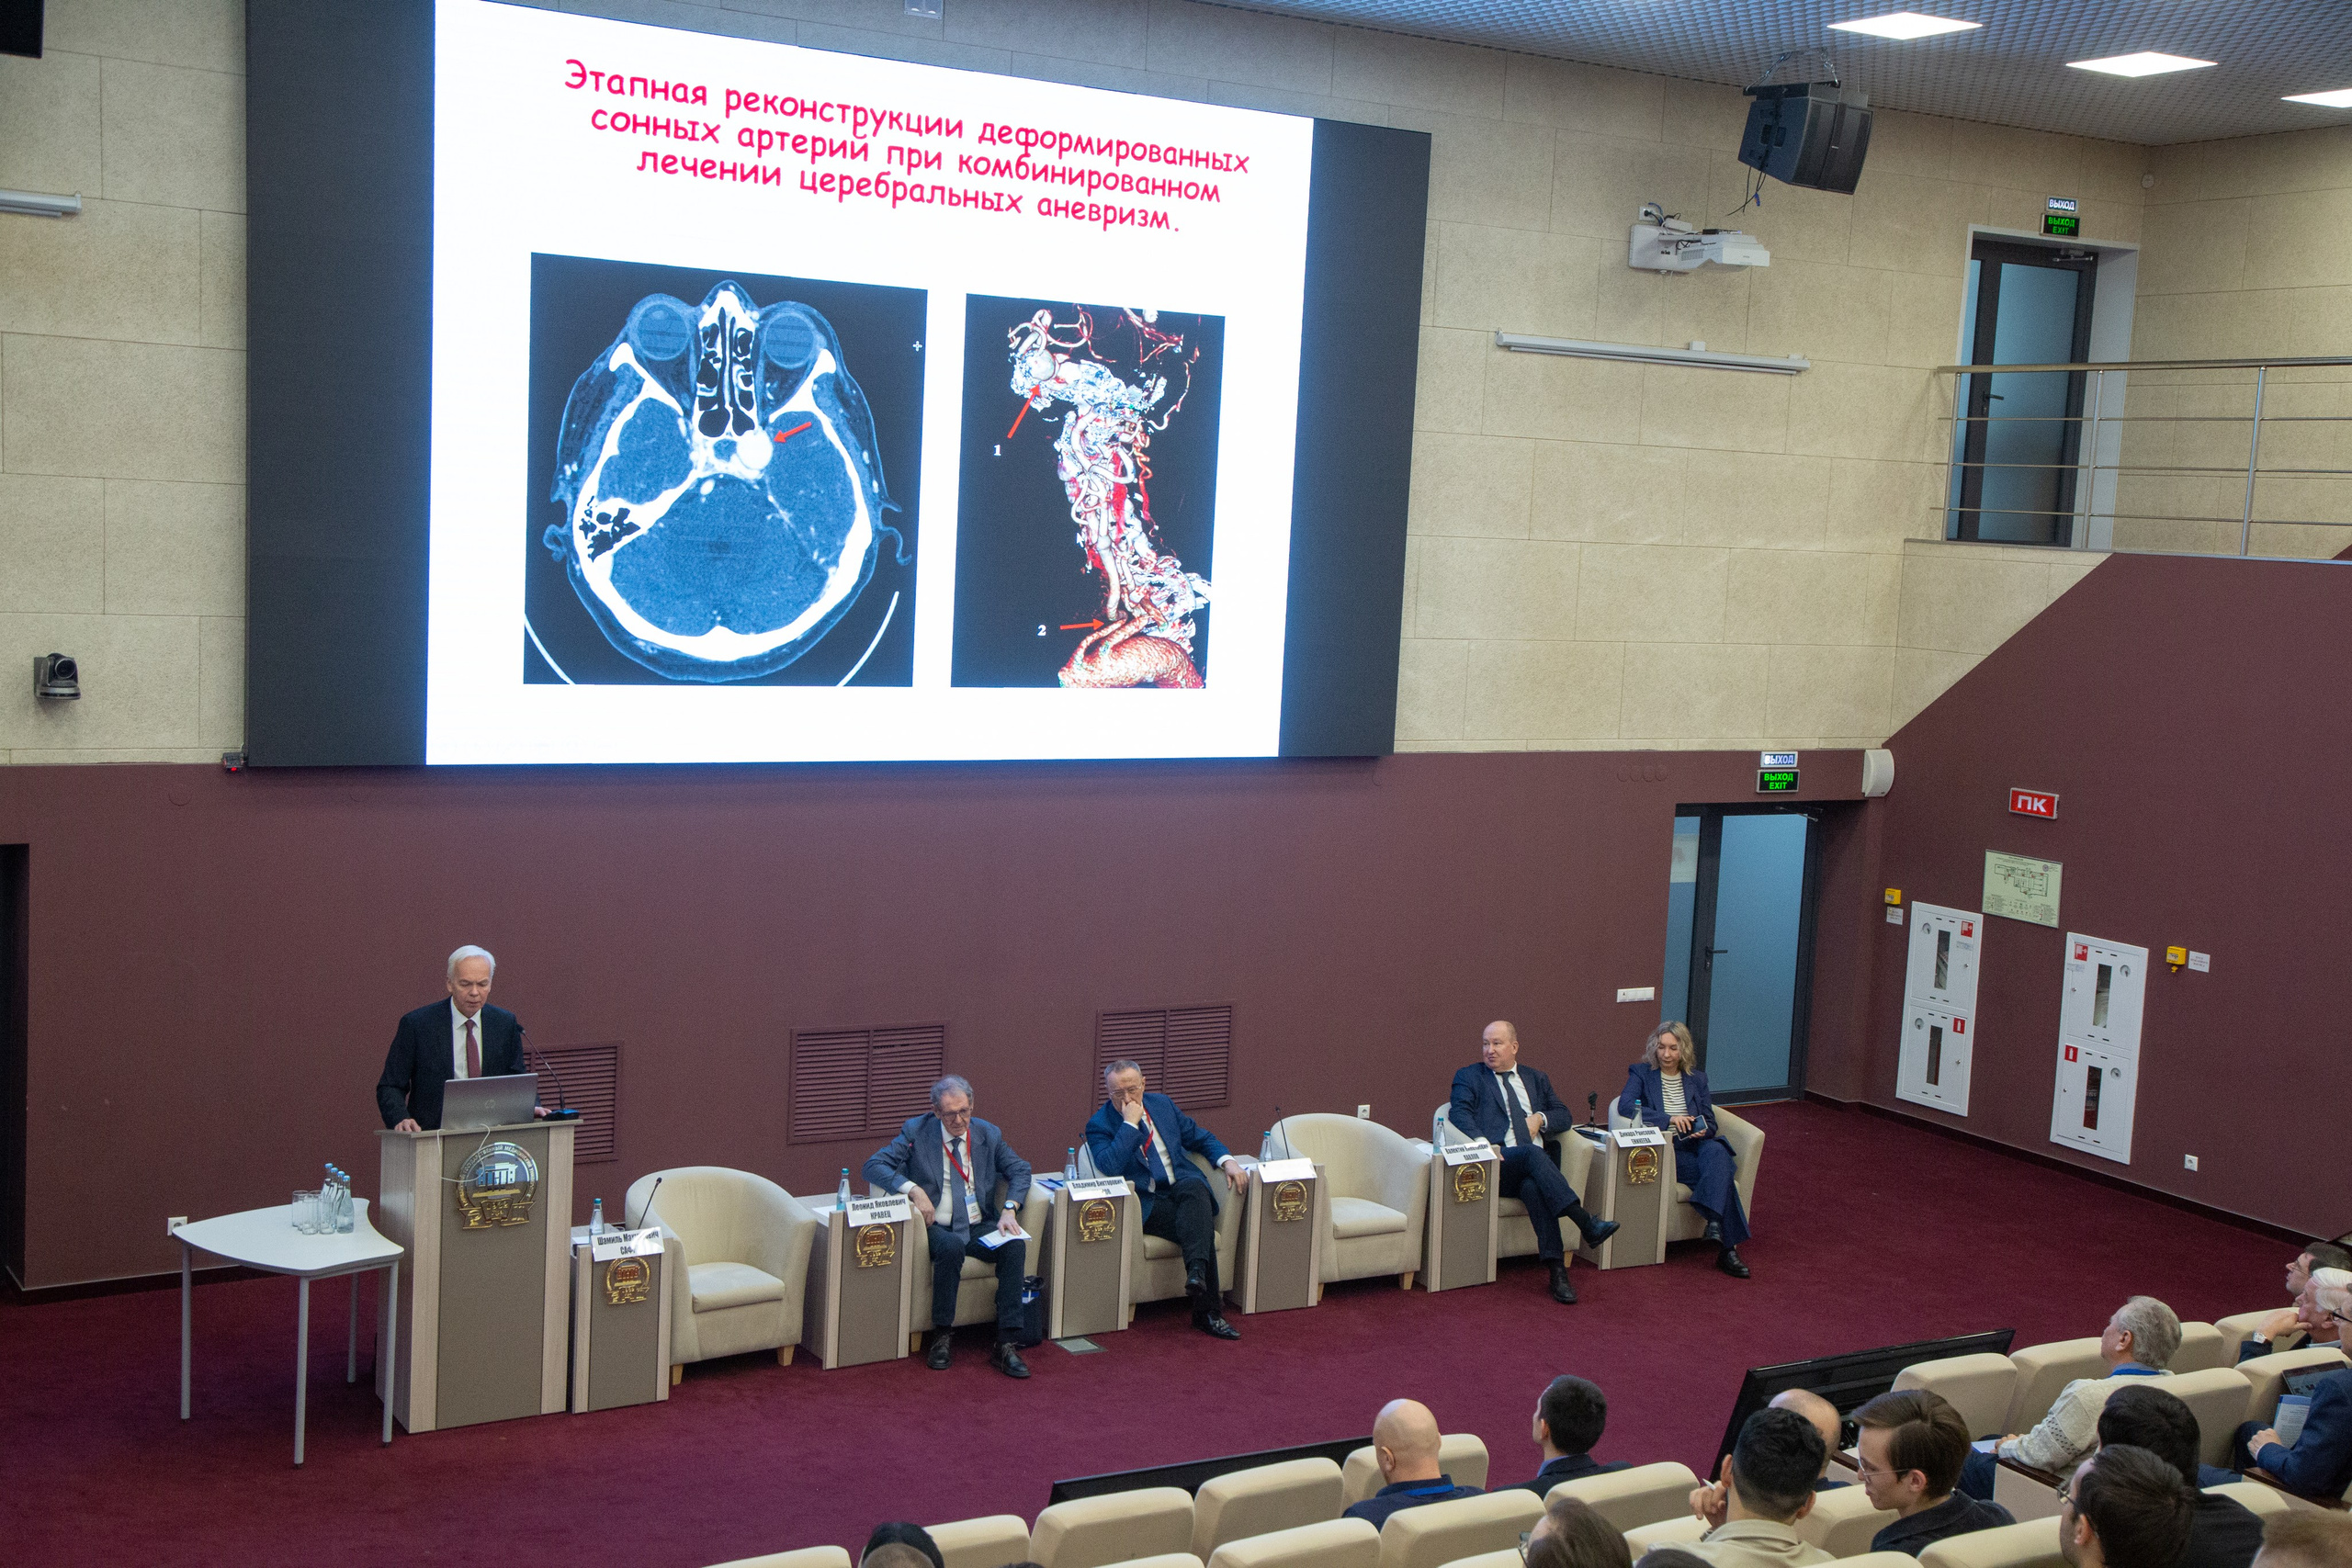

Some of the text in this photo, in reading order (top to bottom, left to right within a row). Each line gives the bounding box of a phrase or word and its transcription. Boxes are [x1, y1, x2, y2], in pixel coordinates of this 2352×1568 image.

[565, 59, 1250, 175] Этапная реконструкции деформированных
[591, 108, 1221, 203] сонных артерий при комбинированном
[636, 151, 1180, 232] лечении церебральных аневризм.
[2049, 198, 2075, 210] ВЫХОД
[2048, 217, 2075, 228] ВЫХОД
[2052, 226, 2069, 234] EXIT
[993, 445, 1001, 456] 1
[1037, 625, 1046, 637] 2
[1764, 754, 1794, 765] ВЫХОД
[1764, 773, 1793, 782] ВЫХОД
[1769, 782, 1788, 790] EXIT
[2017, 795, 2047, 813] ПК
[852, 1198, 906, 1212] Леонид Яковлевич
[870, 1210, 892, 1220] КРАВЕЦ
[597, 1235, 623, 1246] Шамиль
